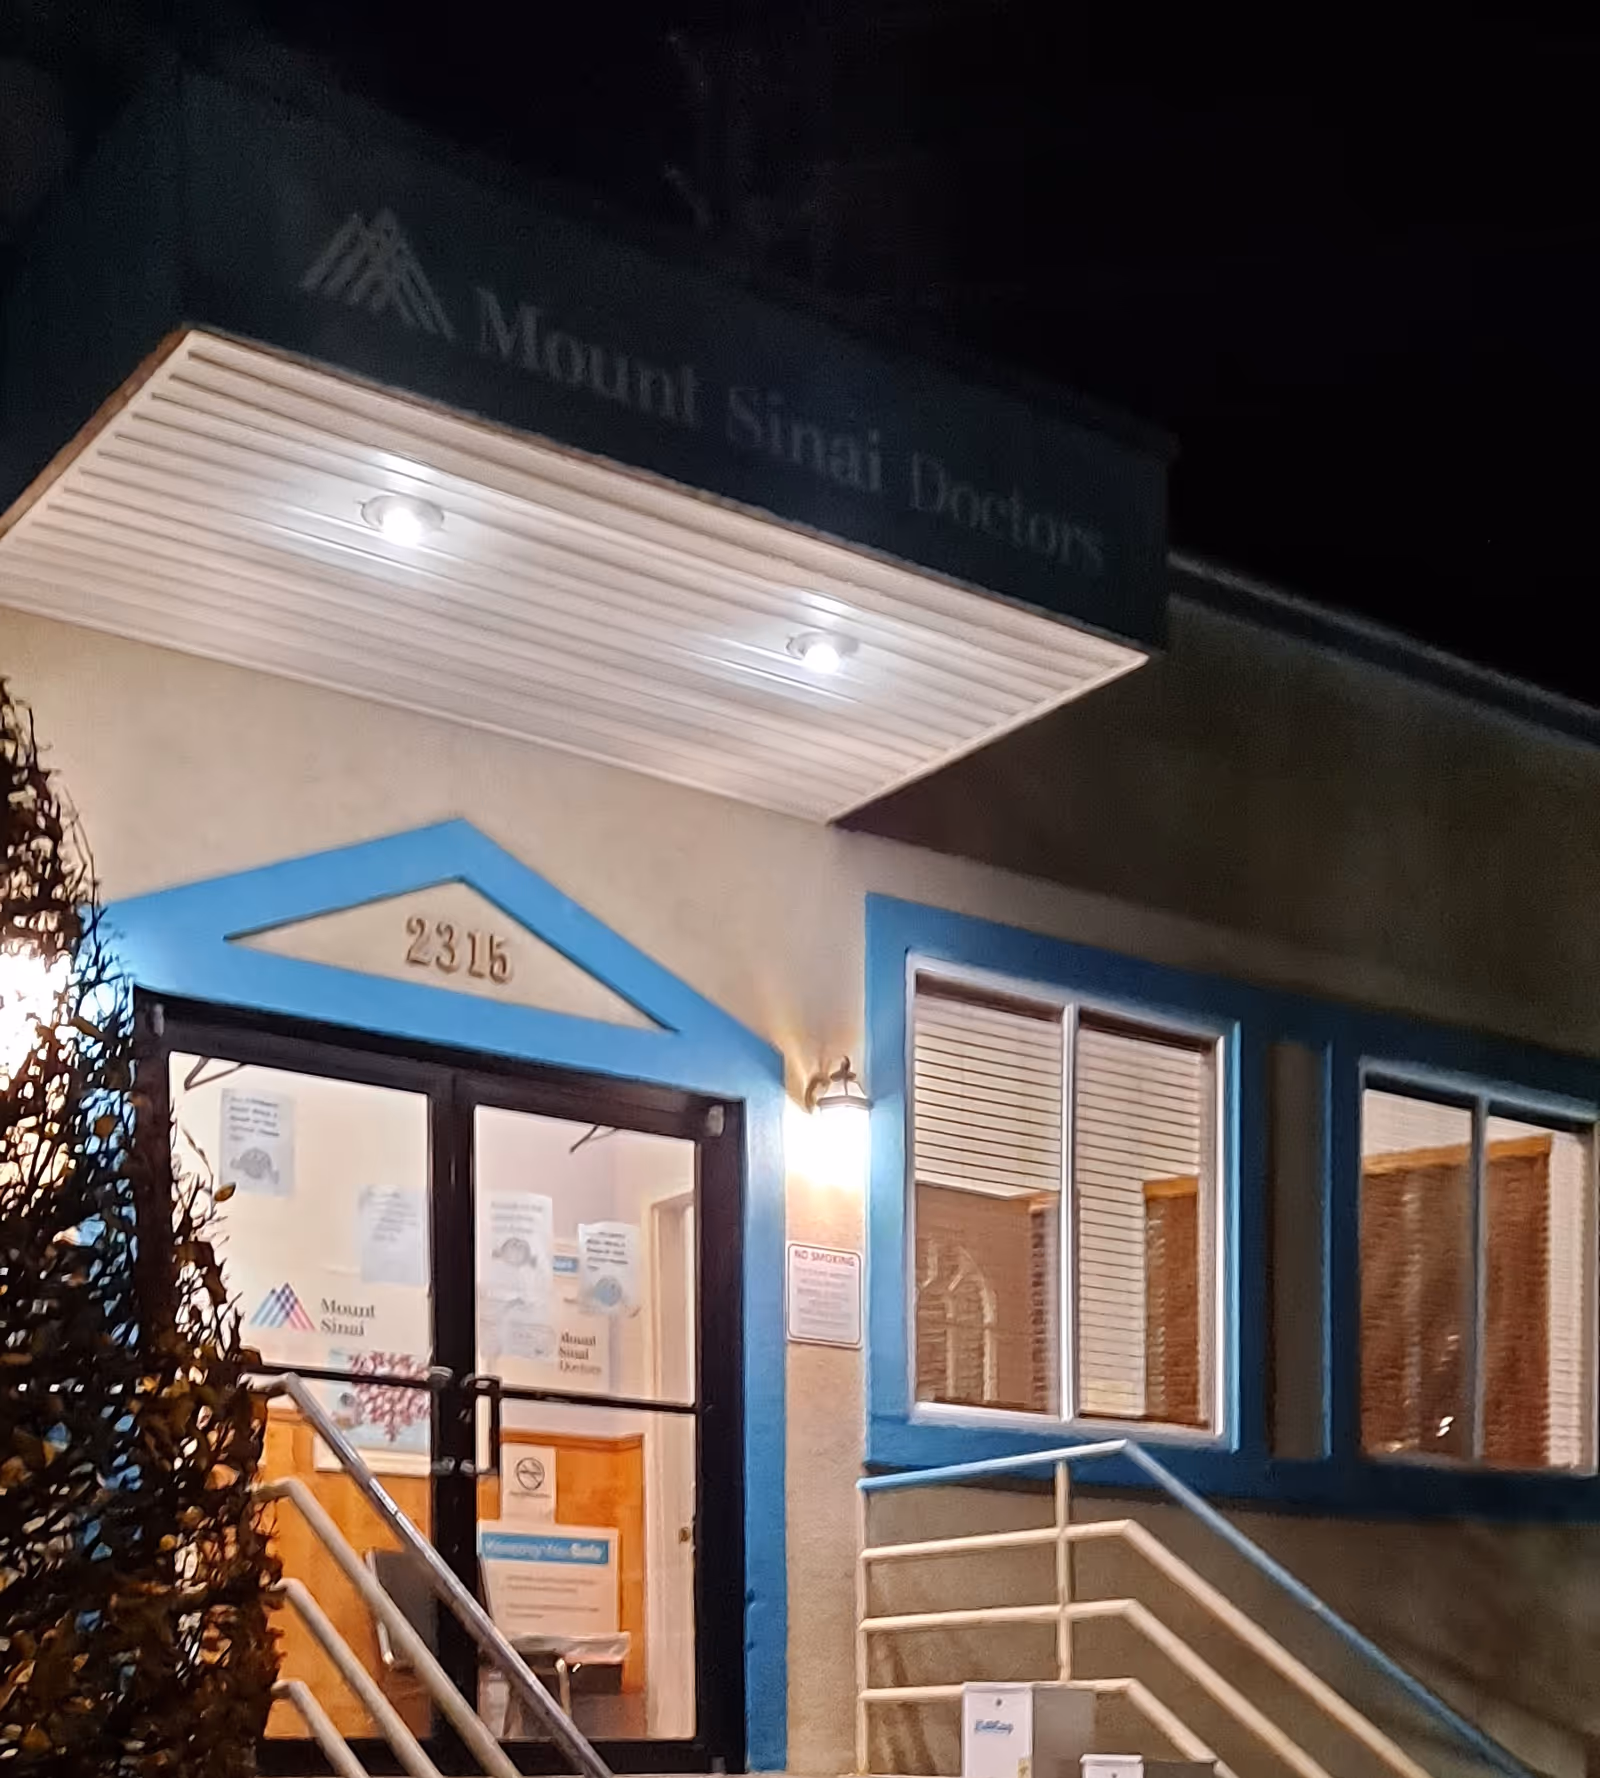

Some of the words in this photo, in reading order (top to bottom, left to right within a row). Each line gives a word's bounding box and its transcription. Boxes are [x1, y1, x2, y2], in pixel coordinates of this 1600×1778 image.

[476, 286, 702, 429] Mount
[725, 384, 883, 492] Sinai
[907, 450, 1105, 570] Doctors
[405, 916, 512, 984] 2315
[794, 1249, 808, 1260] NO
[812, 1252, 855, 1266] SMOKING
[321, 1297, 375, 1319] Mount
[321, 1317, 364, 1337] Sinai
[559, 1346, 590, 1361] Sinai
